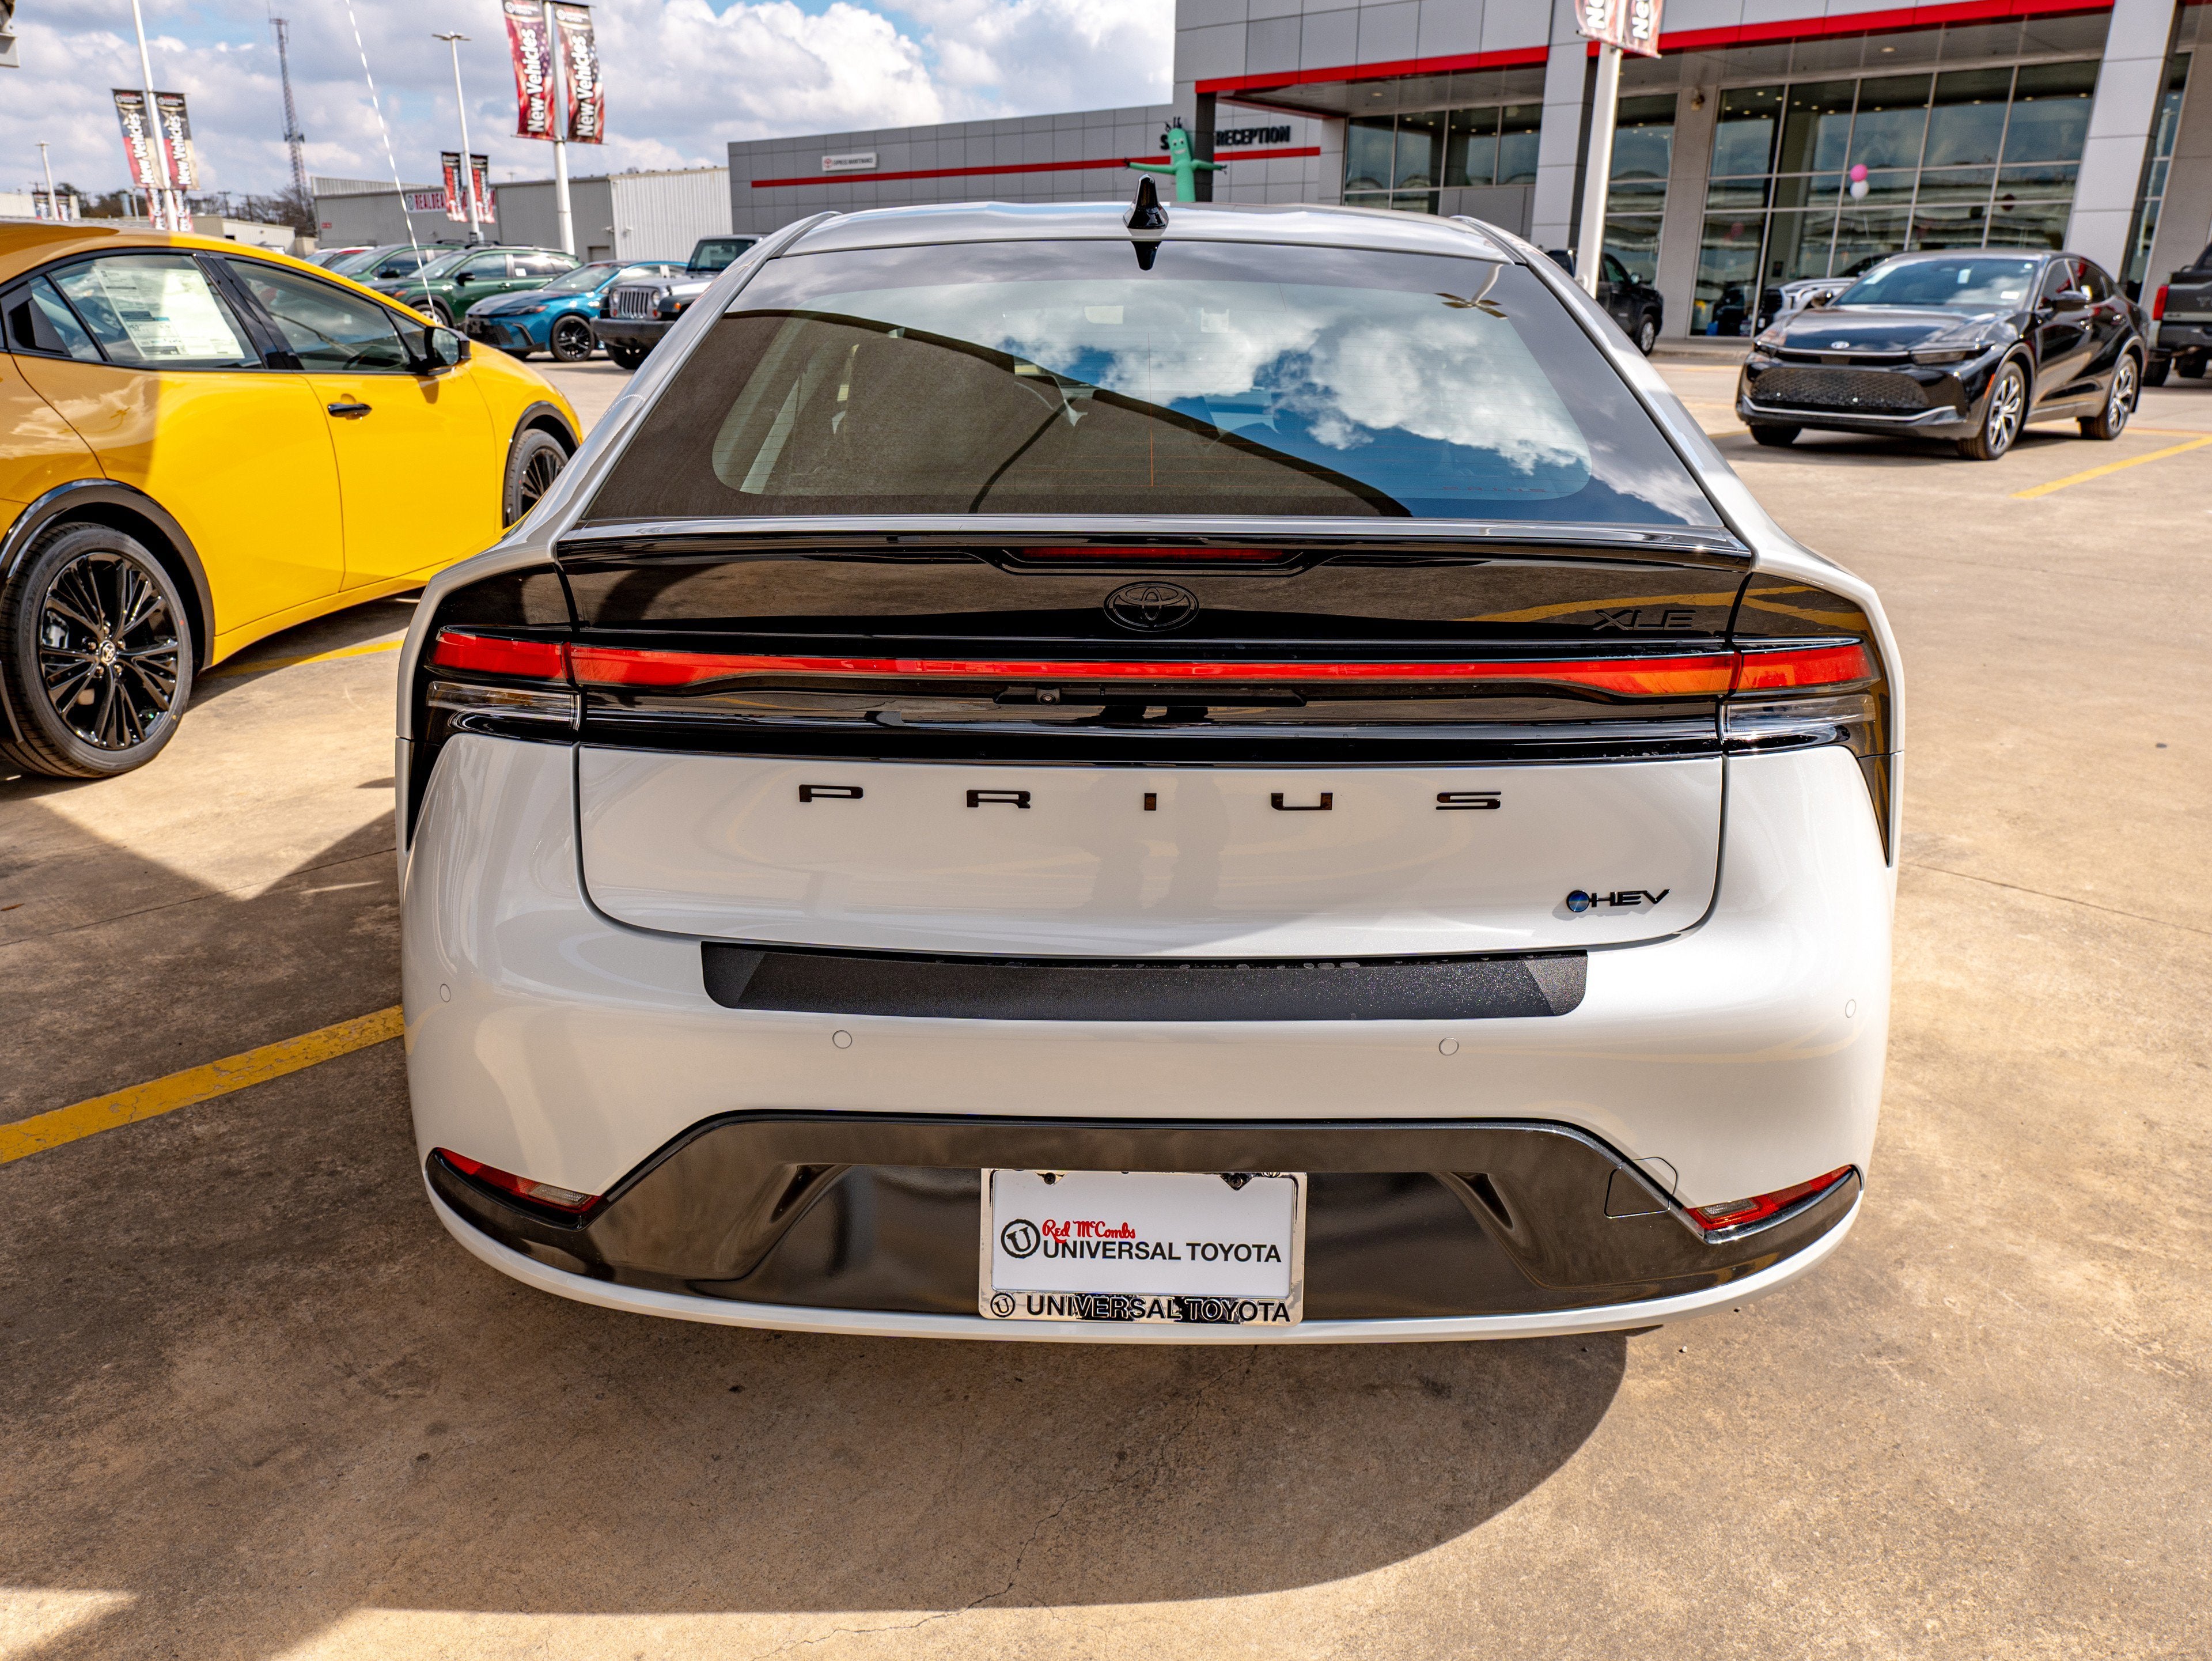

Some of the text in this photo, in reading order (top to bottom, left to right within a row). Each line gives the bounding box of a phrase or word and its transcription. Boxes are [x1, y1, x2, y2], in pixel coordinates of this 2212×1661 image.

[1632, 0, 1649, 39] Ne
[520, 29, 543, 94] Vehicles
[571, 36, 594, 100] Vehicles
[528, 97, 545, 133] New
[577, 101, 594, 137] New
[127, 113, 148, 158] Vehicles
[168, 115, 187, 160] Vehicles
[1216, 125, 1290, 146] RECEPTION
[138, 158, 155, 184] New
[177, 160, 192, 185] New
[1592, 610, 1696, 630] XLE
[798, 784, 1502, 811] PRIUS
[1591, 889, 1672, 908] HEV
[1042, 1219, 1136, 1244] Red McCombs
[1044, 1240, 1181, 1260] UNIVERSAL
[1186, 1242, 1282, 1263] TOYOTA
[1027, 1294, 1183, 1319] UNIVERSAL
[1184, 1298, 1291, 1322] TOYOTA
